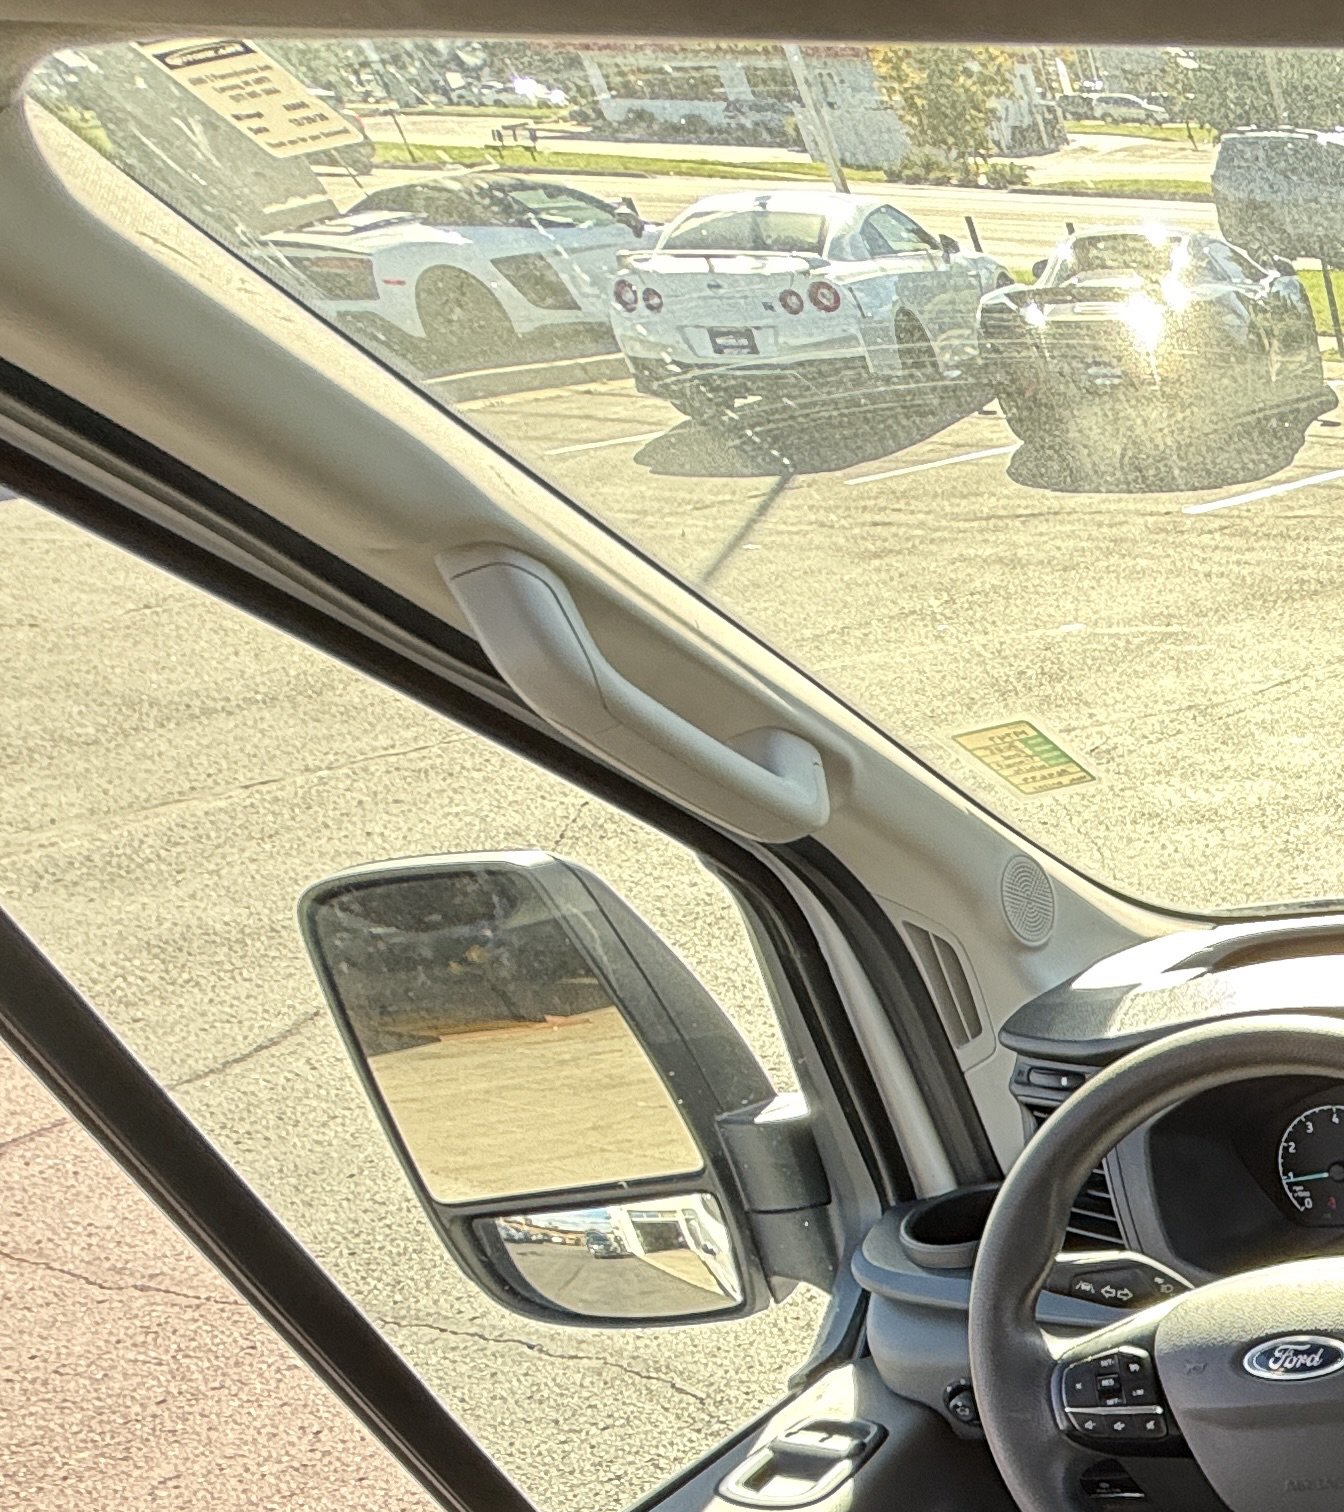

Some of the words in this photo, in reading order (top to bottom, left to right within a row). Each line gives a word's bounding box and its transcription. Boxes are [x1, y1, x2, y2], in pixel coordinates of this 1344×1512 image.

[1331, 1114, 1340, 1125] 4
[1305, 1122, 1314, 1134] 3
[1288, 1141, 1296, 1153] 2
[1304, 1197, 1313, 1209] 0
[1268, 1344, 1325, 1371] Ford
